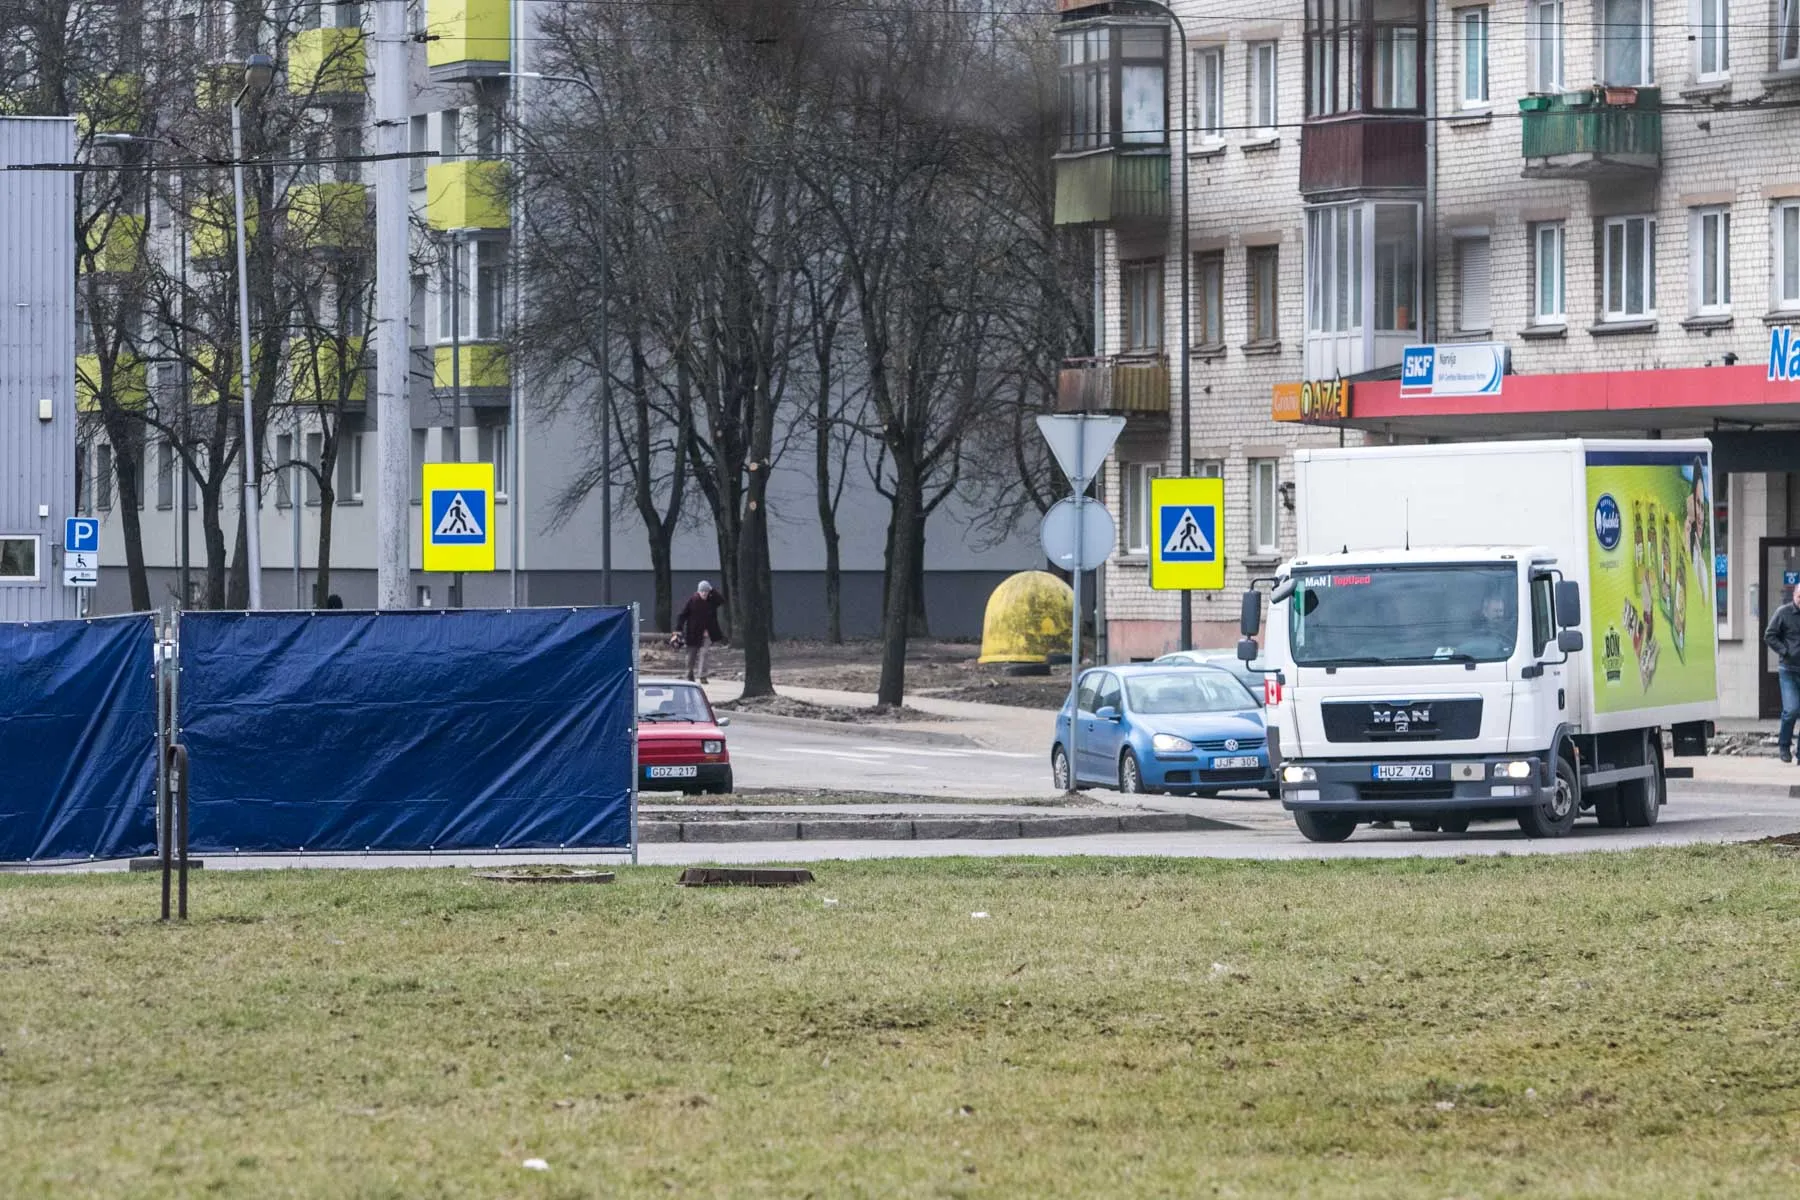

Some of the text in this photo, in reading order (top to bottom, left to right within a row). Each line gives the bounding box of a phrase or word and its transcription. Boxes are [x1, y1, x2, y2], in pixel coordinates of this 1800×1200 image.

[1405, 355, 1432, 377] SKF
[74, 522, 93, 548] P
[1373, 710, 1429, 723] MAN
[1216, 757, 1257, 768] JJF 305
[652, 766, 696, 777] GDZ 217
[1379, 766, 1432, 778] HUZ 746
